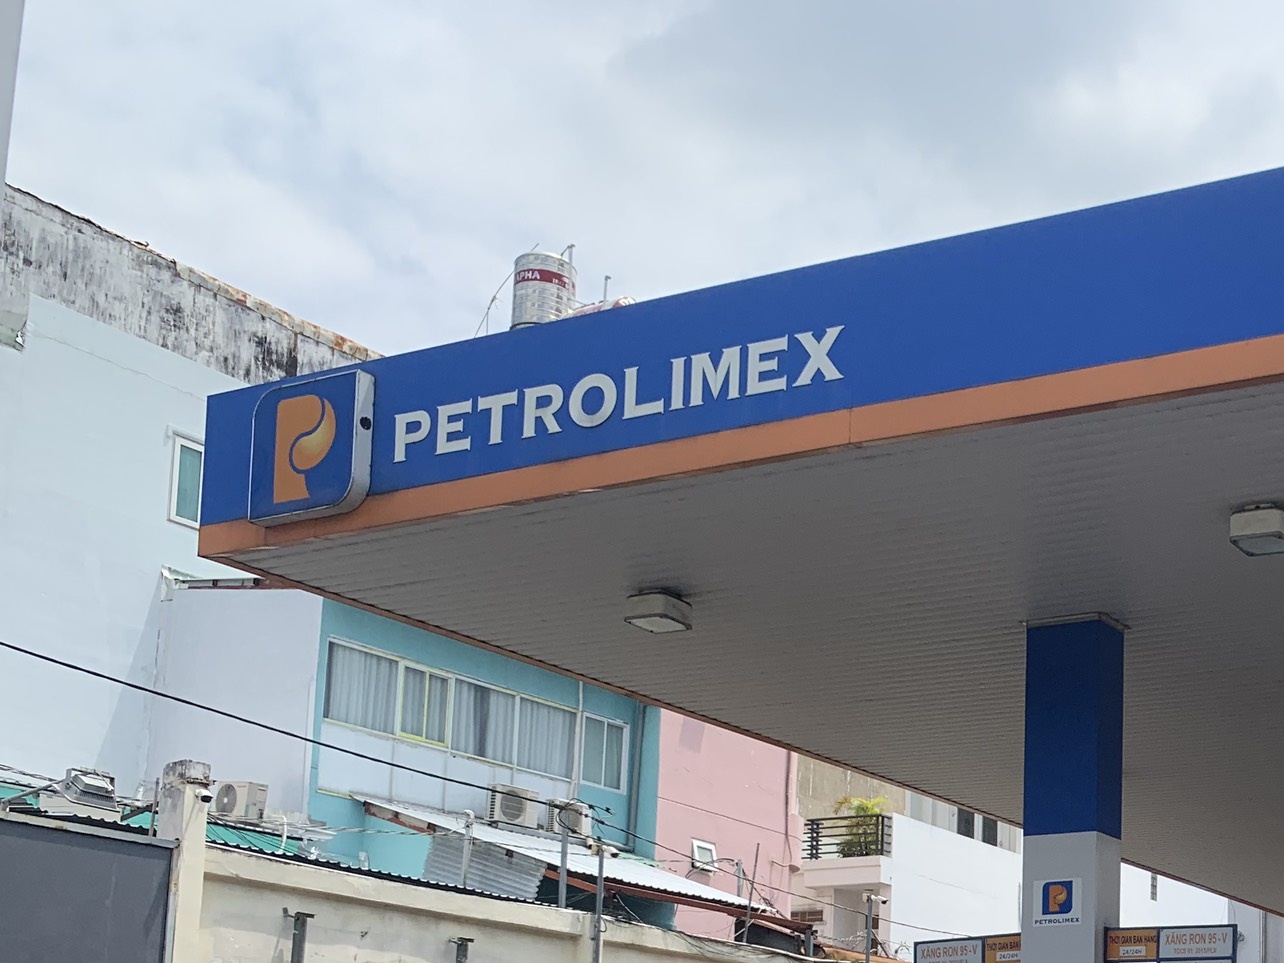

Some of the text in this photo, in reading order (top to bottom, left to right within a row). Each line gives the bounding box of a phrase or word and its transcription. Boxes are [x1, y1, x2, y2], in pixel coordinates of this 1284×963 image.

[392, 325, 845, 463] PETROLIMEX
[1034, 917, 1080, 925] PETROLIMEX
[1165, 933, 1186, 945] XĂNG
[1188, 934, 1206, 945] RON
[920, 947, 941, 960] XĂNG
[942, 945, 959, 957] RON
